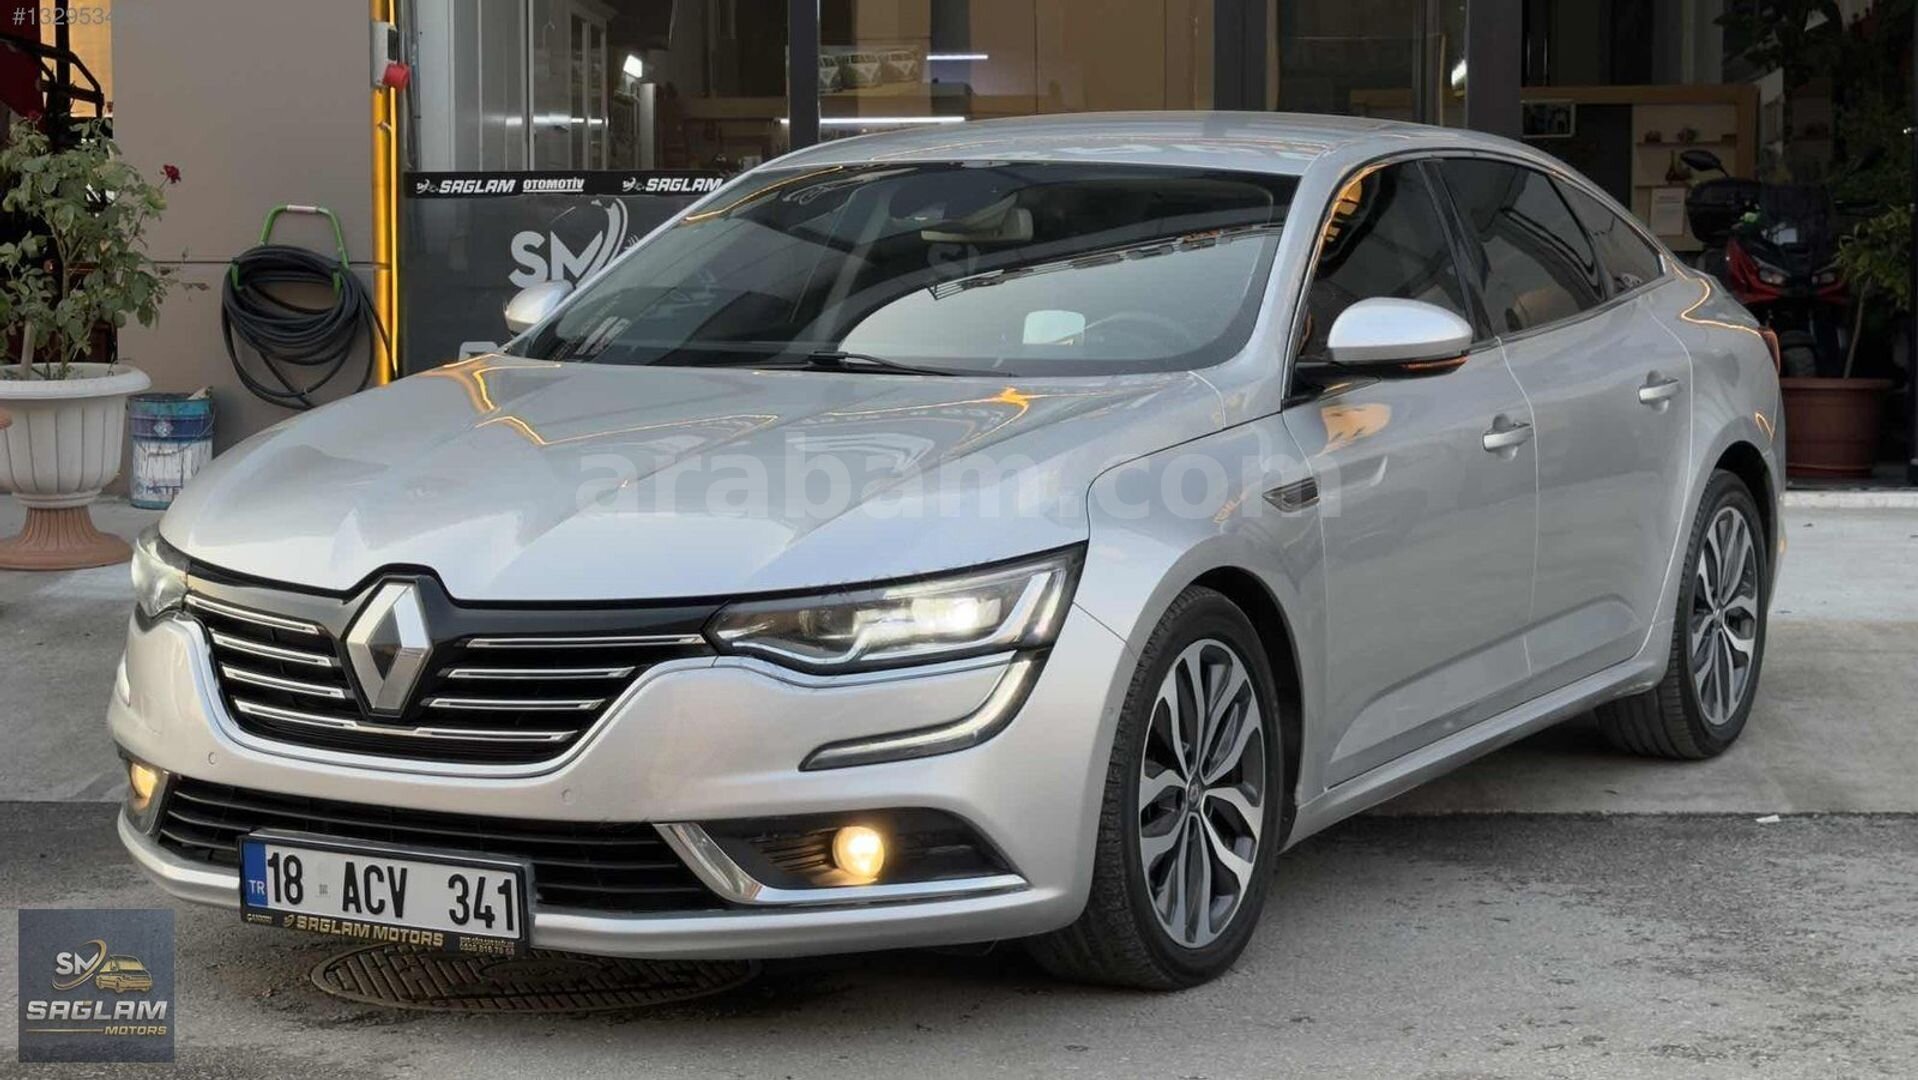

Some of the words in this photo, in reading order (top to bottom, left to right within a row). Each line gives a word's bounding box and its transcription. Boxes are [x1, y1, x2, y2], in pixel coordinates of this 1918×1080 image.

[439, 179, 516, 194] SAGLAM
[645, 177, 723, 192] SAGLAM
[249, 880, 265, 895] TR
[267, 852, 304, 905] 18
[342, 861, 408, 919] ACV
[448, 874, 514, 931] 341
[296, 915, 370, 939] SAGLAM
[372, 923, 443, 947] MOTORS
